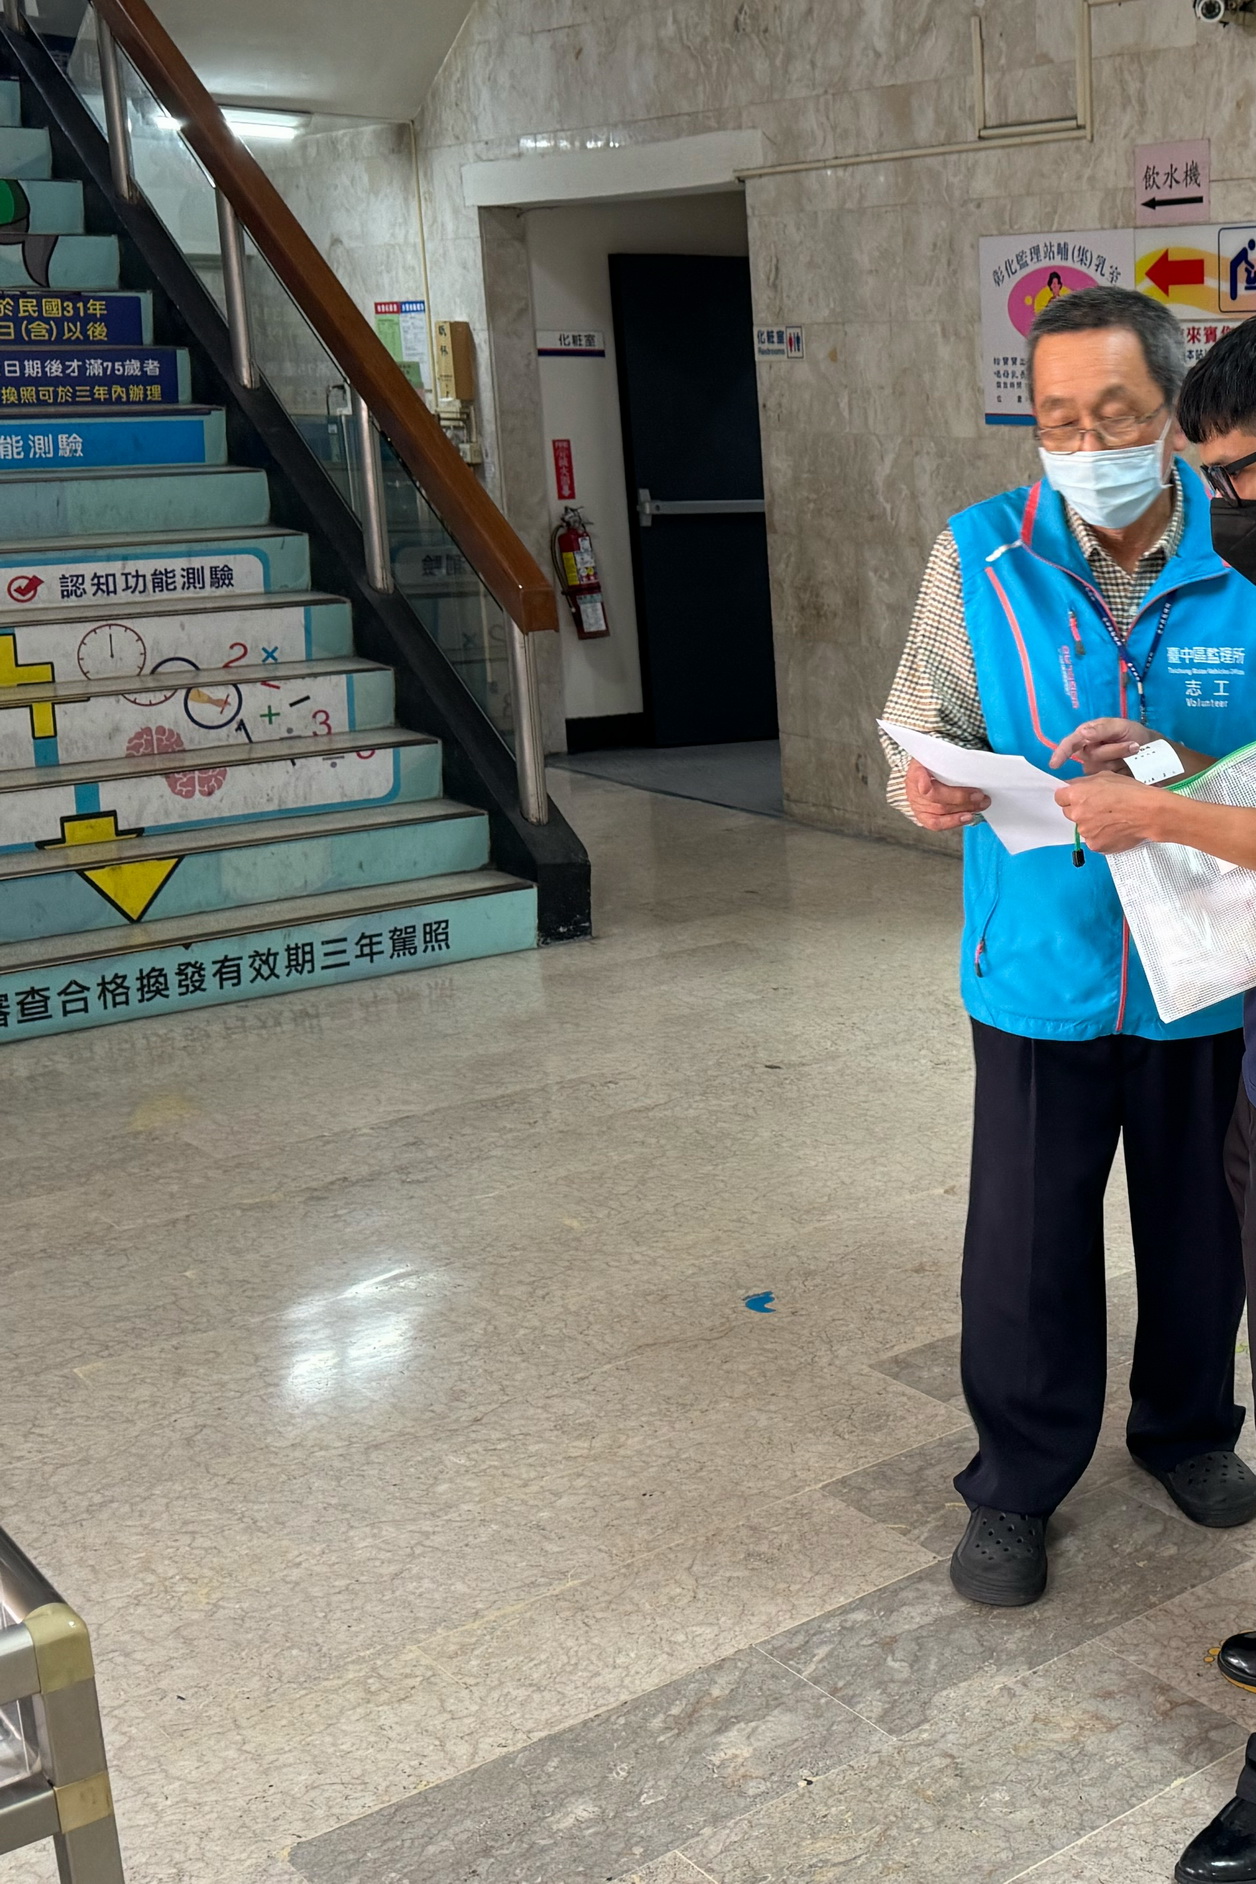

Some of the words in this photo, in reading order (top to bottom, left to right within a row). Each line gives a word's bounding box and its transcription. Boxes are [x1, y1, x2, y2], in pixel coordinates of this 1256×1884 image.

[1142, 160, 1201, 190] 飲水機
[0, 298, 107, 318] 於民國31年
[0, 321, 108, 341] 日(含)以後
[4, 359, 160, 378] 日期後才滿75歲者
[1, 385, 162, 404] 換照可於三年內辦理
[0, 434, 83, 460] 能測驗
[59, 564, 234, 599] 認知功能測驗
[1184, 680, 1230, 696] 志工
[1185, 698, 1229, 708] Volunteer
